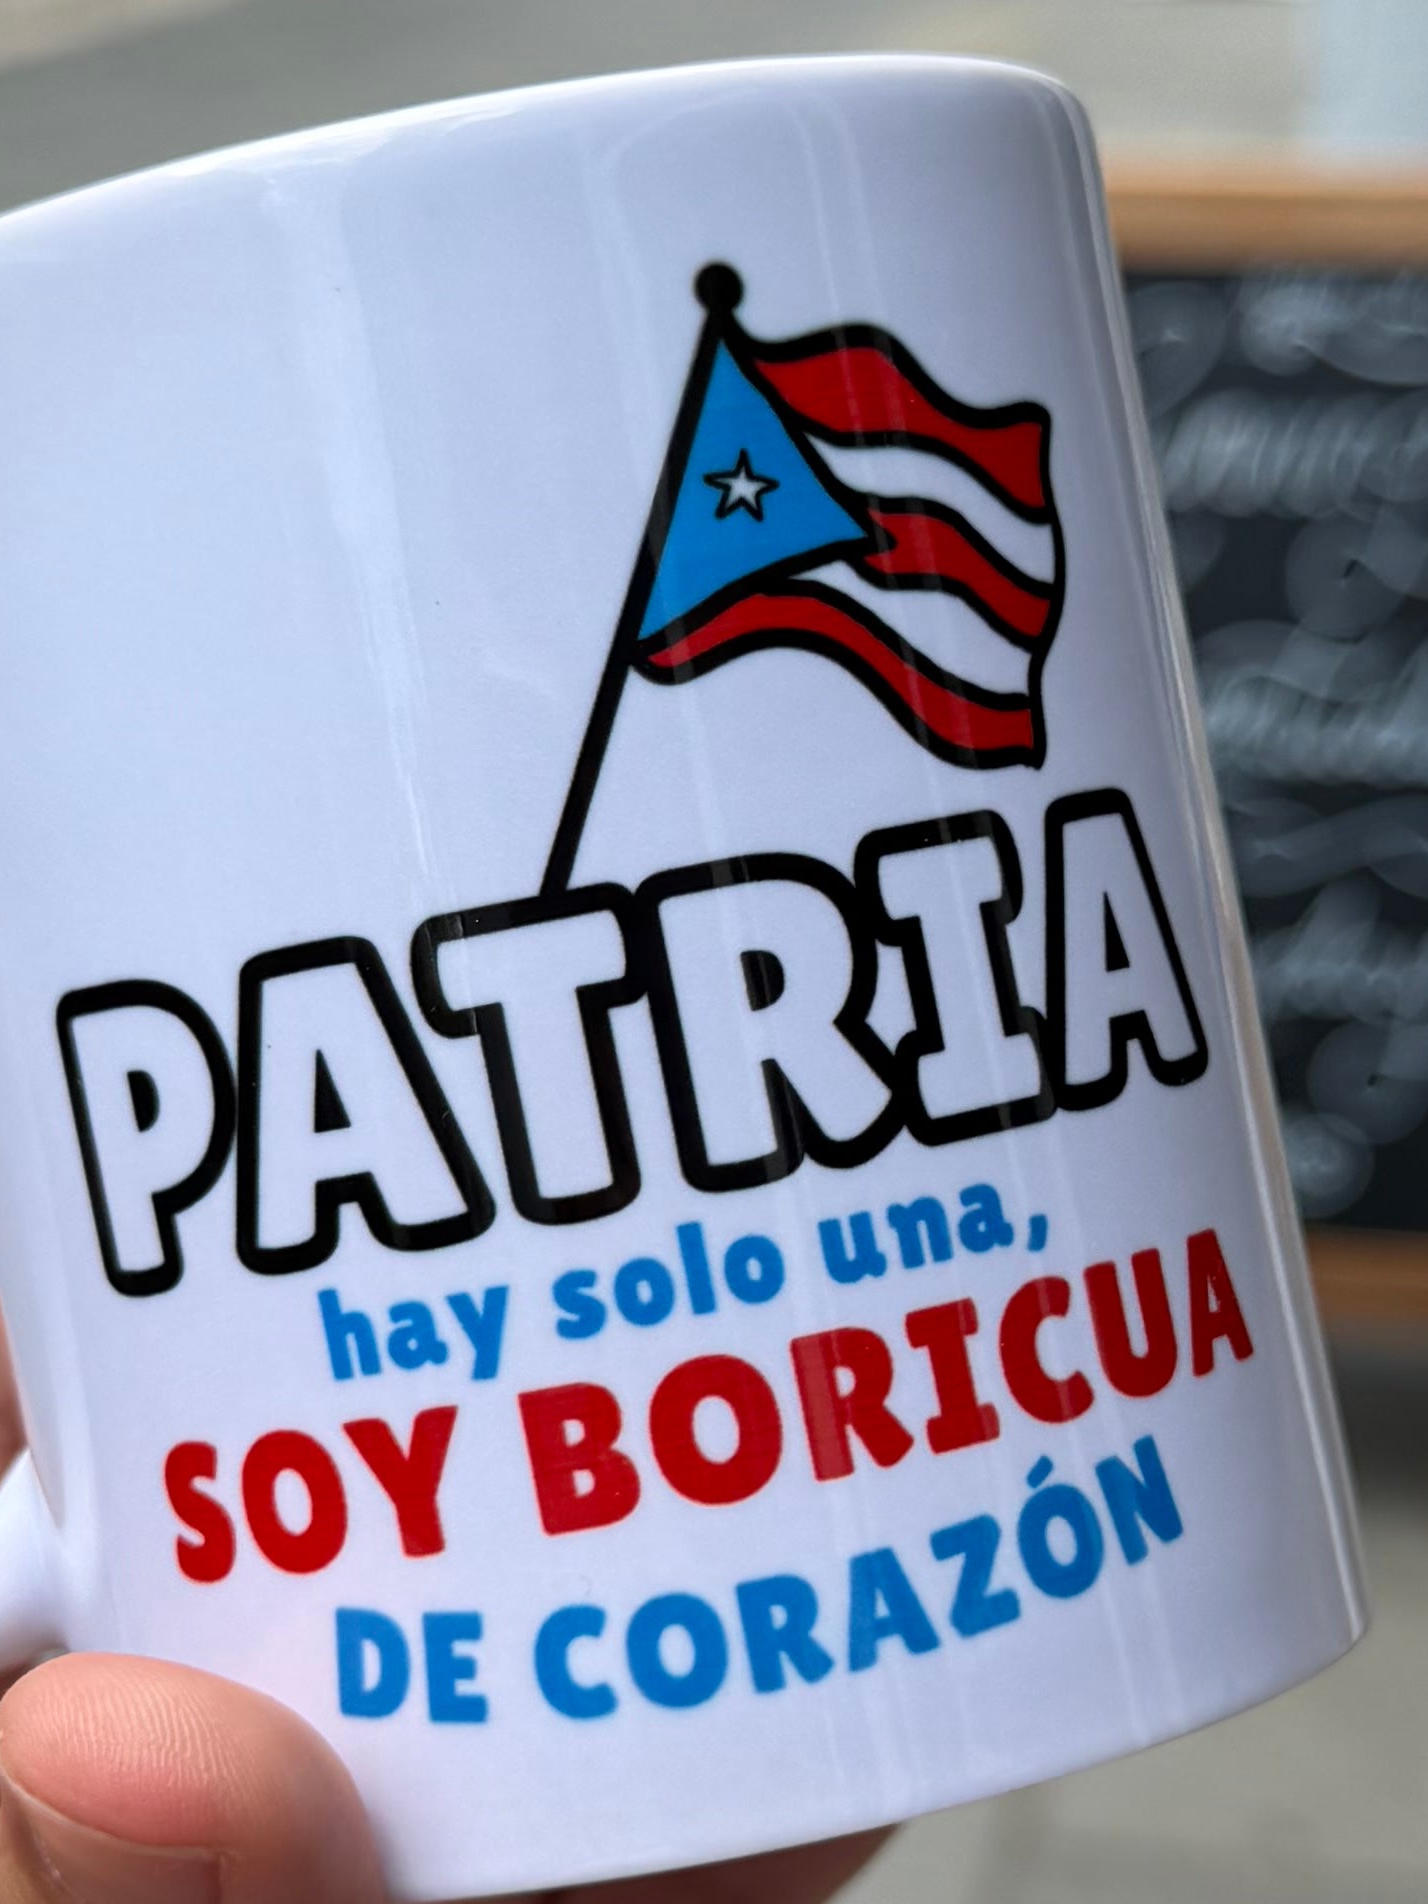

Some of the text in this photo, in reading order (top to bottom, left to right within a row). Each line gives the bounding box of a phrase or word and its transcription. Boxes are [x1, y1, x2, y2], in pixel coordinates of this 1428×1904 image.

[56, 788, 1210, 1296] PATRIA
[164, 1229, 1254, 1582] SOY BORICUA
[317, 1183, 1051, 1381] hay solo una,
[334, 1436, 1185, 1723] DE CORAZÓN
